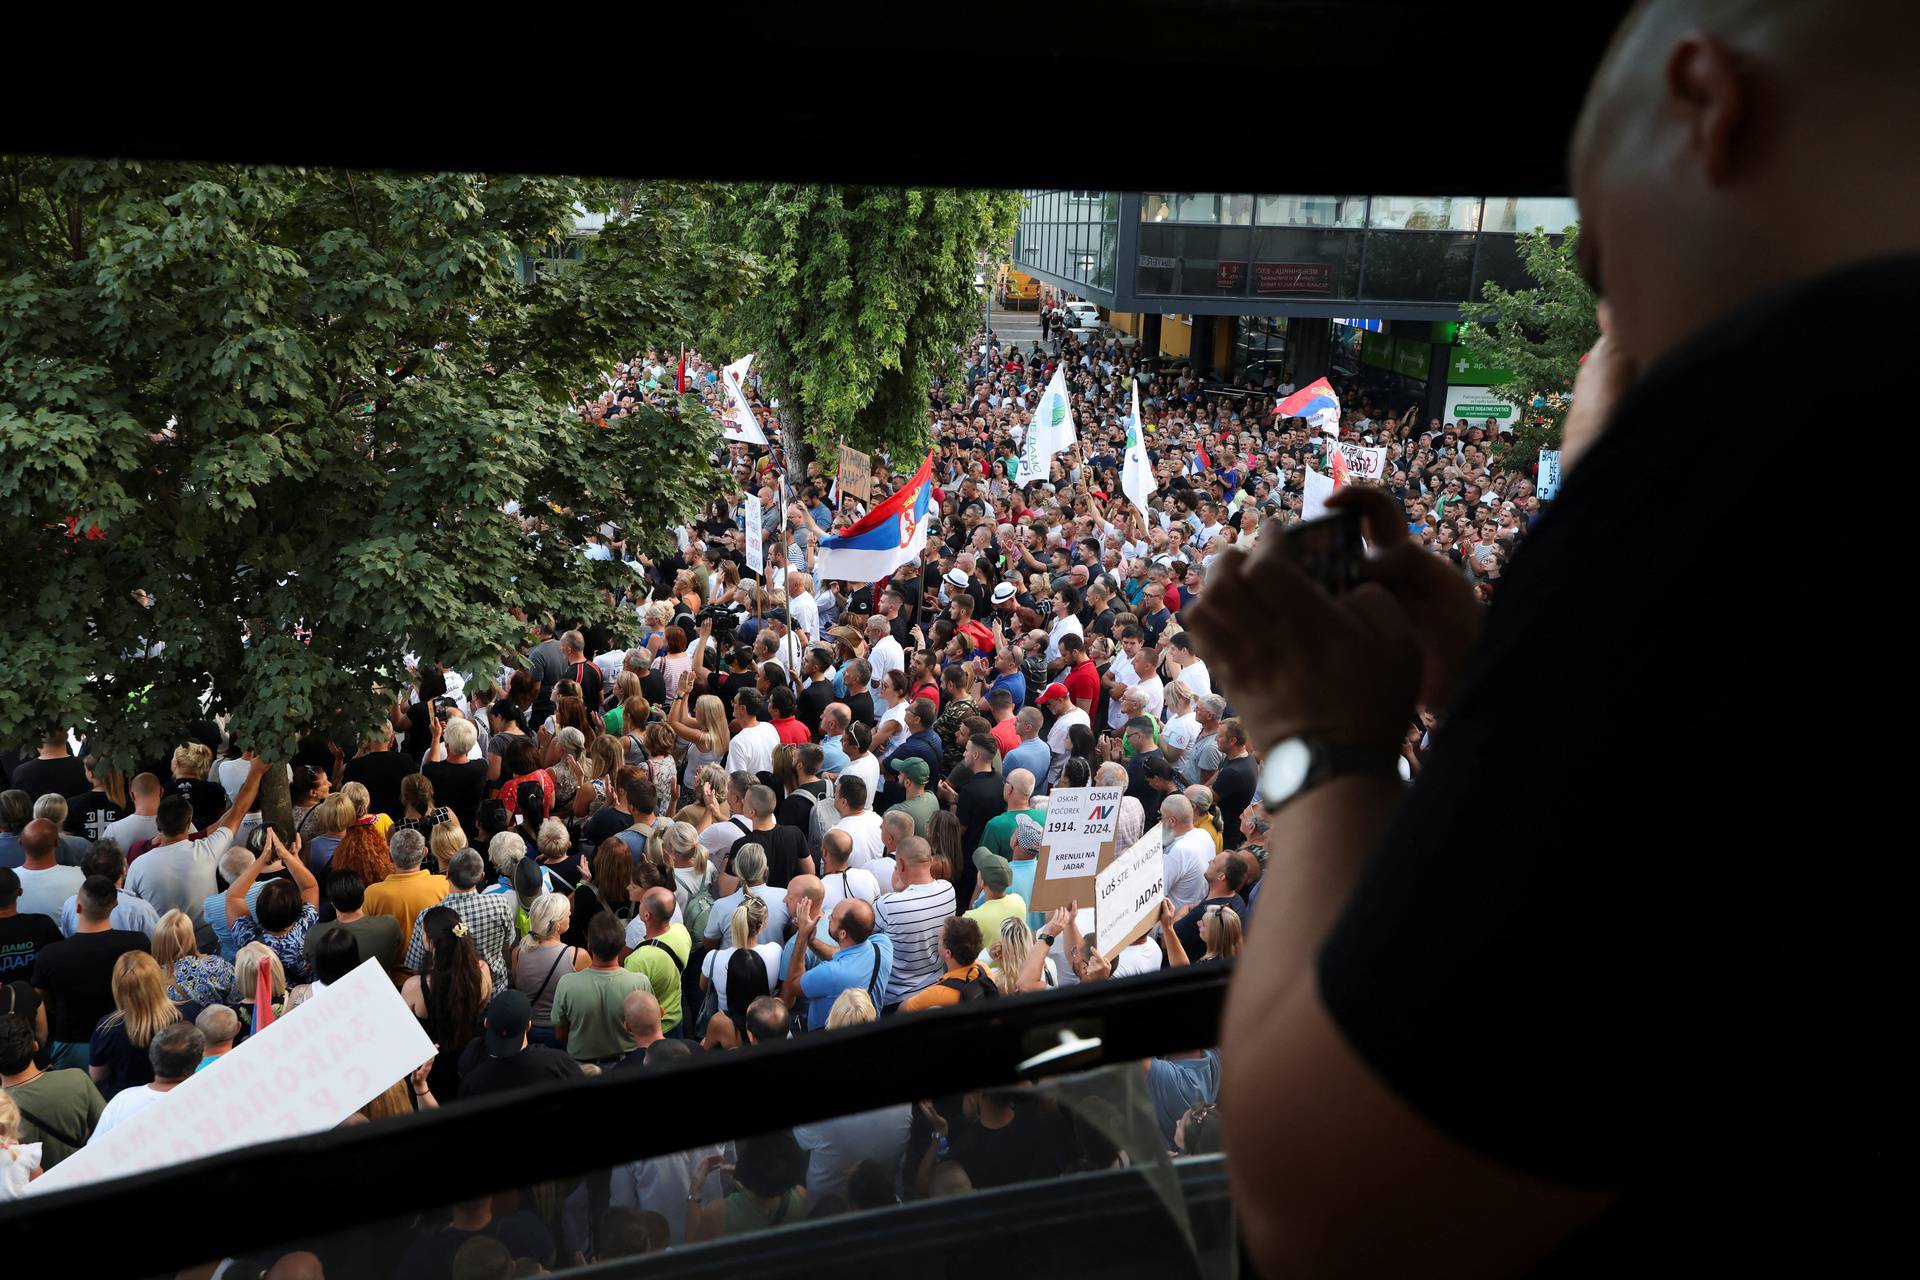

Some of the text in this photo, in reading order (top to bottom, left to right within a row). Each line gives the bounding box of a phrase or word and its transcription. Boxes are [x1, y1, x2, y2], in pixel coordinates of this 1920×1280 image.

[1029, 436, 1042, 473] ДАМО
[1057, 795, 1079, 803] OSKAR
[1089, 792, 1119, 802] OSKAR
[1048, 821, 1077, 833] 1914.
[1083, 823, 1112, 835] 2024.
[1055, 851, 1096, 861] KRENULI NA
[1062, 862, 1085, 871] JADAR
[1101, 876, 1117, 900] LOŠ
[1116, 868, 1129, 887] STE
[1134, 877, 1164, 913] JADAR
[1, 941, 34, 954] ДАМО
